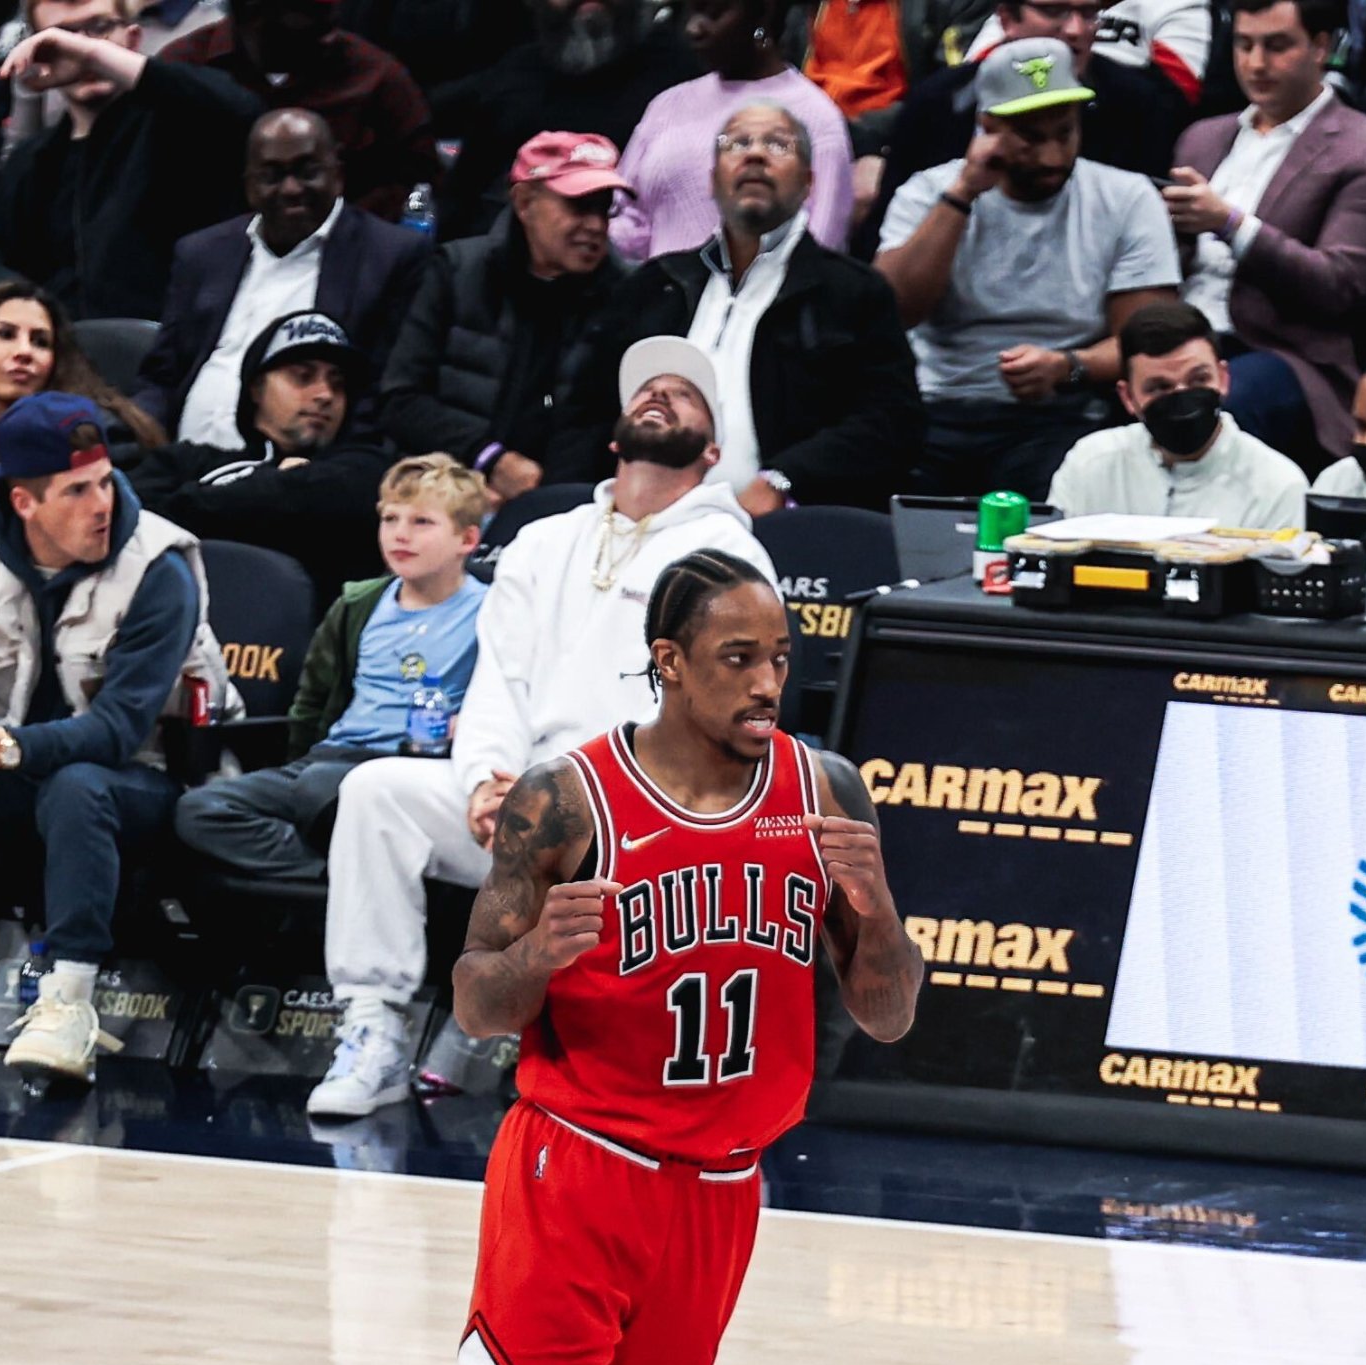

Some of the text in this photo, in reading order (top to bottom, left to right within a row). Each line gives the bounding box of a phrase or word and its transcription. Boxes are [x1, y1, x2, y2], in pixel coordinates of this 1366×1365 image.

[753, 814, 803, 829] ZENNI
[754, 829, 804, 839] EYEWEAR
[615, 862, 817, 977] BULLS
[905, 916, 1074, 973] Rmax
[662, 967, 758, 1087] 11
